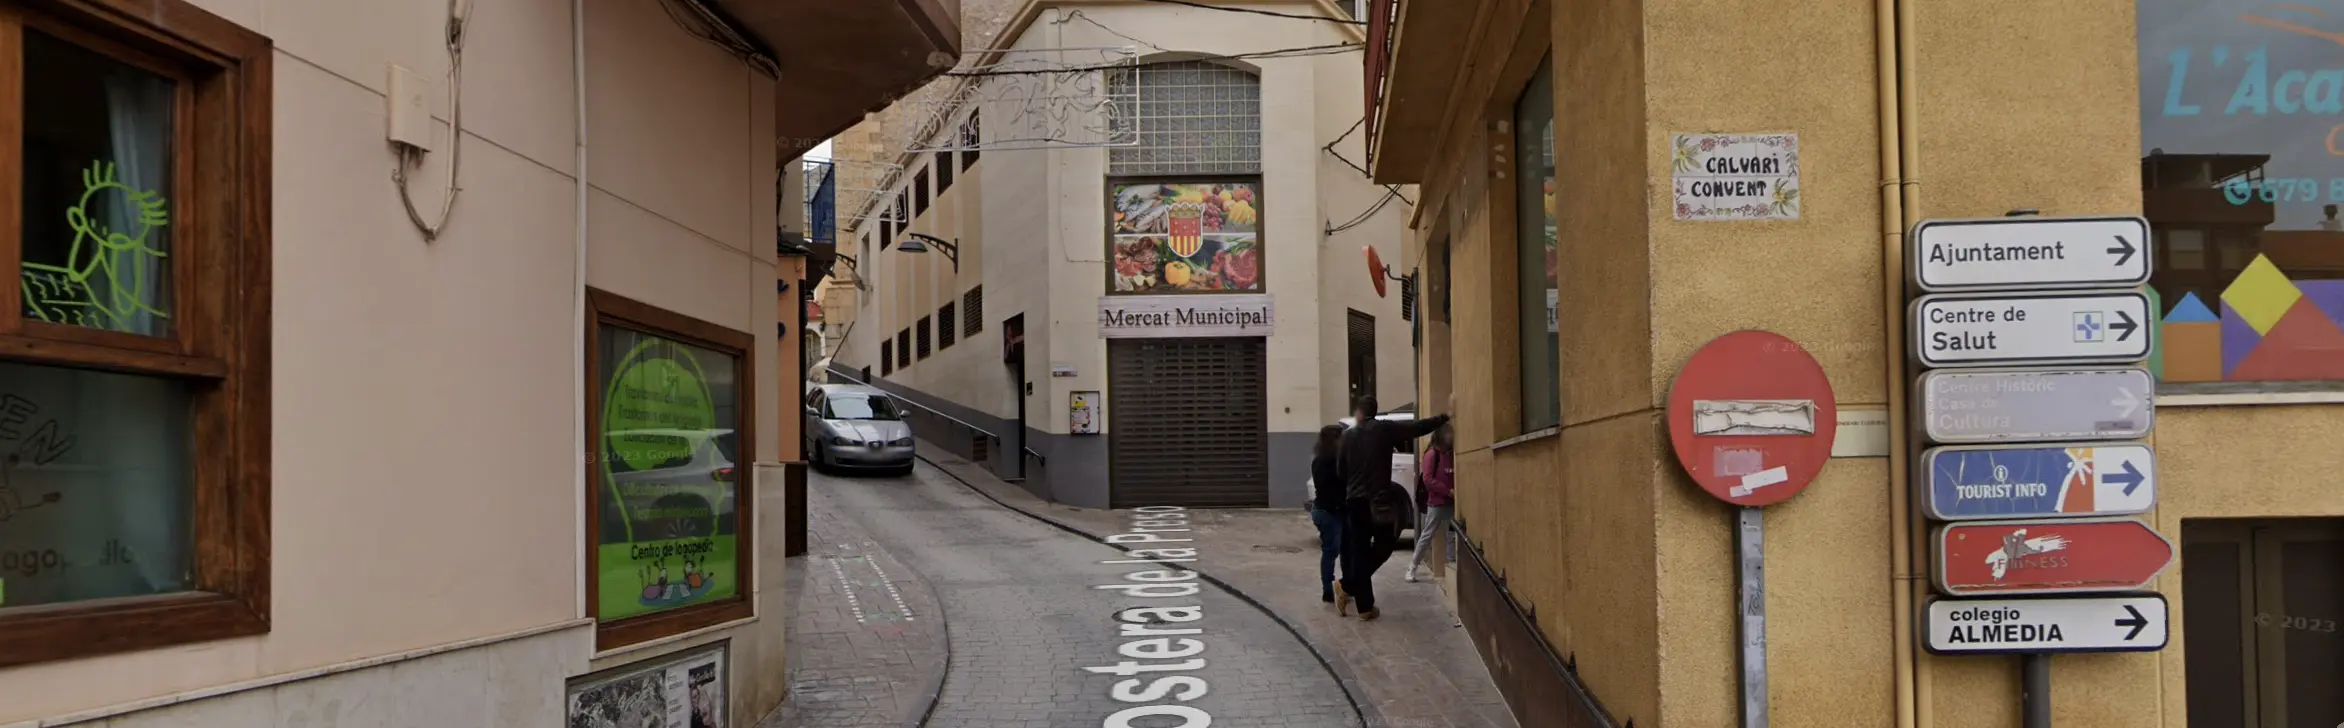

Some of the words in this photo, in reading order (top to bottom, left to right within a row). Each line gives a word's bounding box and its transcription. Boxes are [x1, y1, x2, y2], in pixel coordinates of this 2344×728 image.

[1691, 180, 1767, 197] CONVENT
[2260, 178, 2318, 203] 679
[1929, 241, 2065, 266] Ajuntament
[1104, 309, 1170, 327] Mercat
[1175, 307, 1268, 329] Municipal
[1930, 308, 1996, 324] Centre
[2003, 306, 2026, 322] de
[1932, 331, 1997, 351] Salut
[1938, 381, 1989, 394] Centre
[1940, 414, 2011, 429] Cultura
[1956, 484, 2012, 499] TOURIST
[2015, 483, 2047, 498] INFO
[631, 544, 660, 560] Centro
[662, 542, 674, 557] de
[1950, 607, 2020, 624] colegio
[1948, 624, 2064, 643] ALMEDIA
